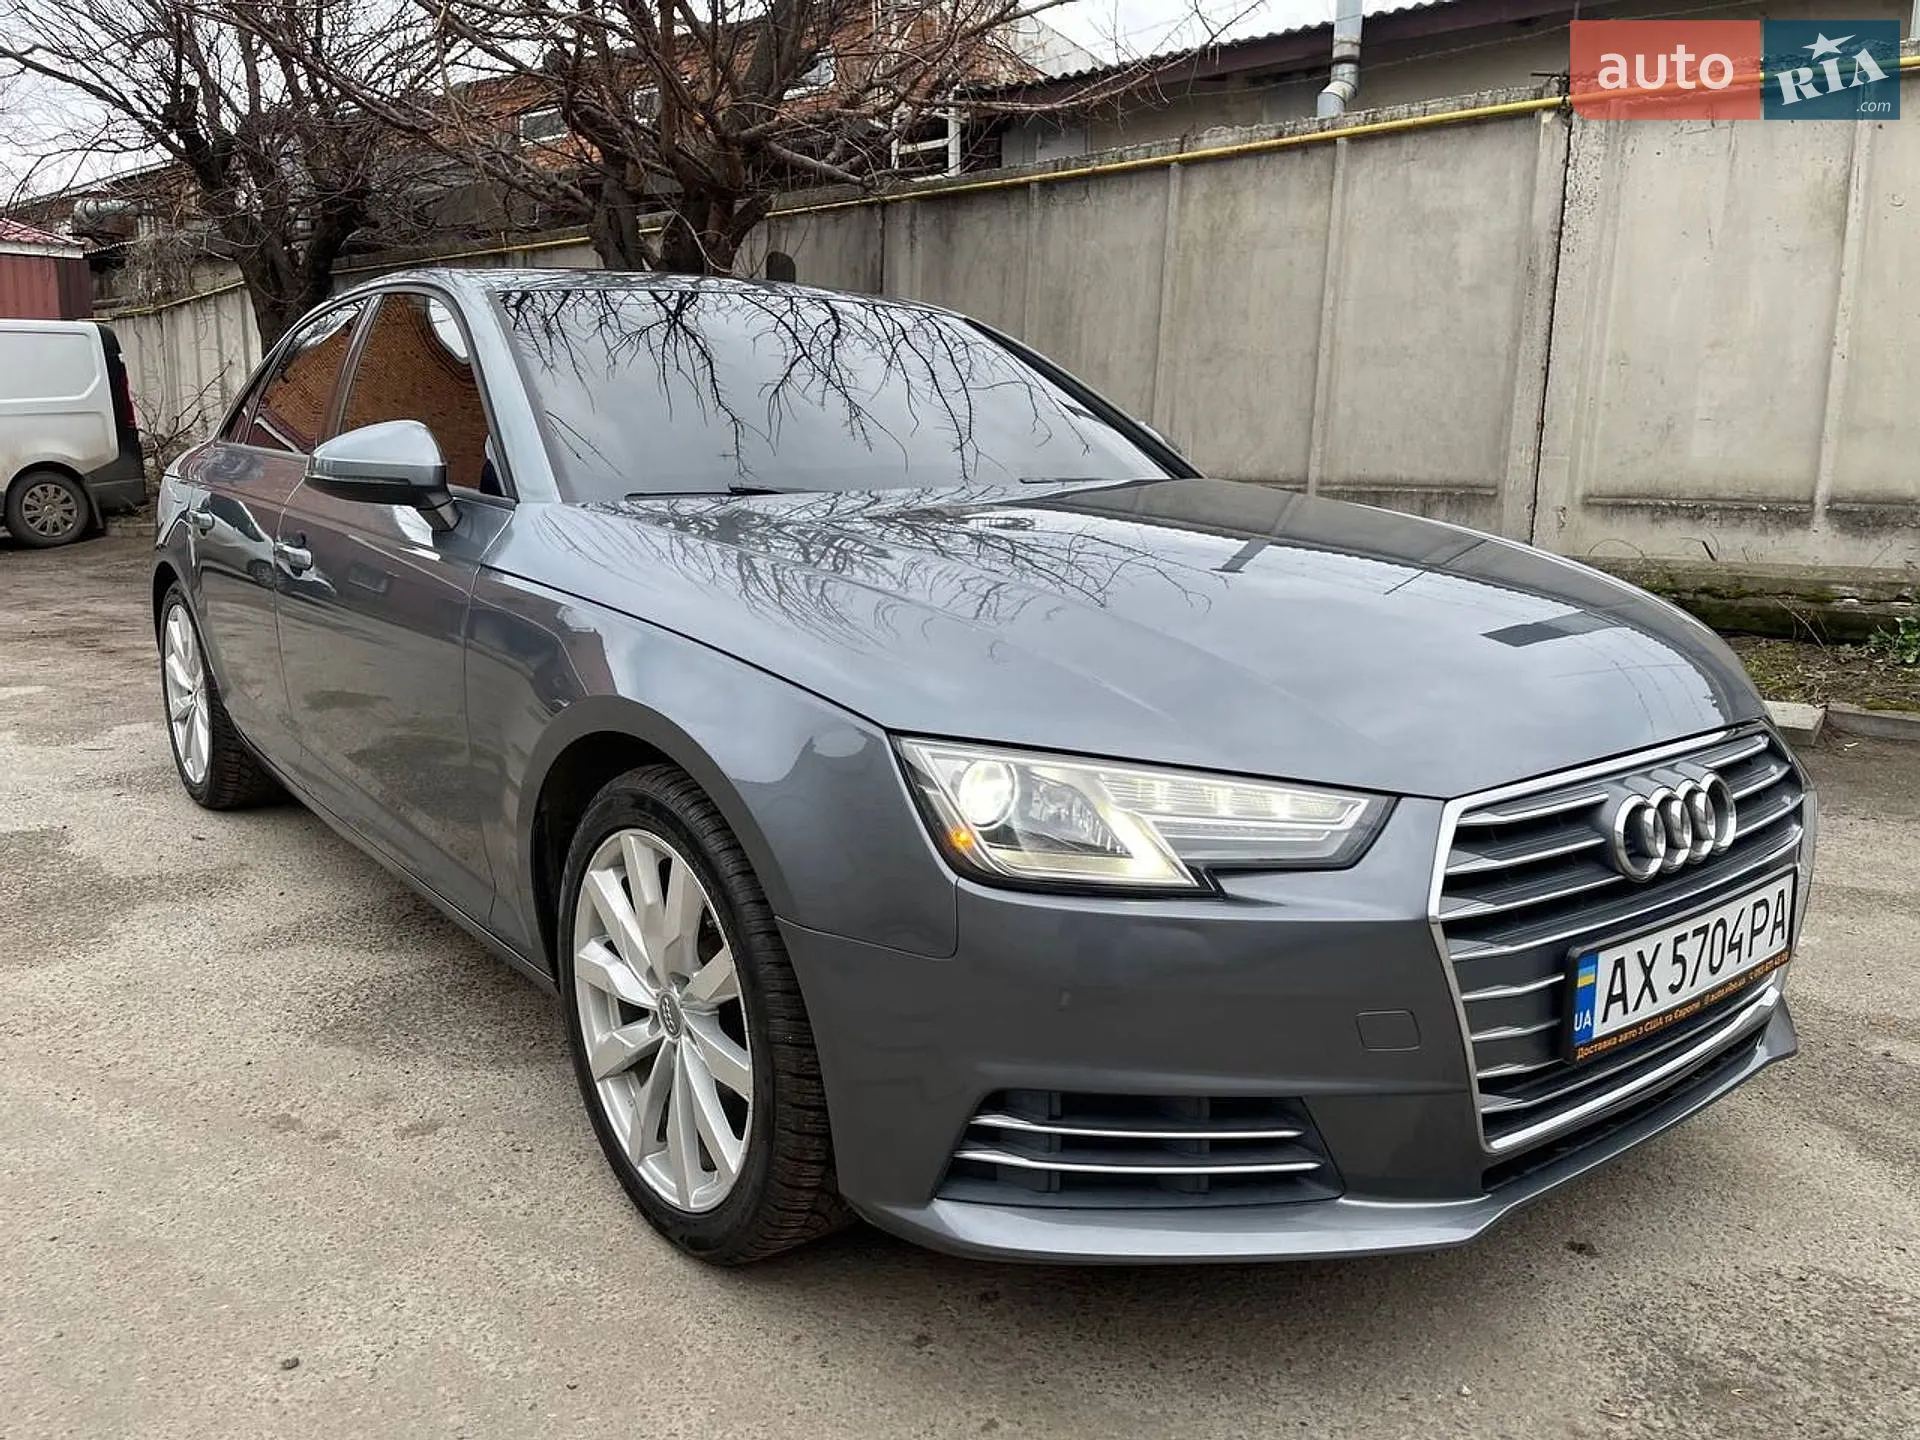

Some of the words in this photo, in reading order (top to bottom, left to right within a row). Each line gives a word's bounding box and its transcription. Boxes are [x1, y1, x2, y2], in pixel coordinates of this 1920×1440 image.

[1602, 942, 1662, 1024] AX
[1668, 907, 1745, 995] 5704
[1573, 1008, 1593, 1032] UA
[1644, 1016, 1664, 1032] США
